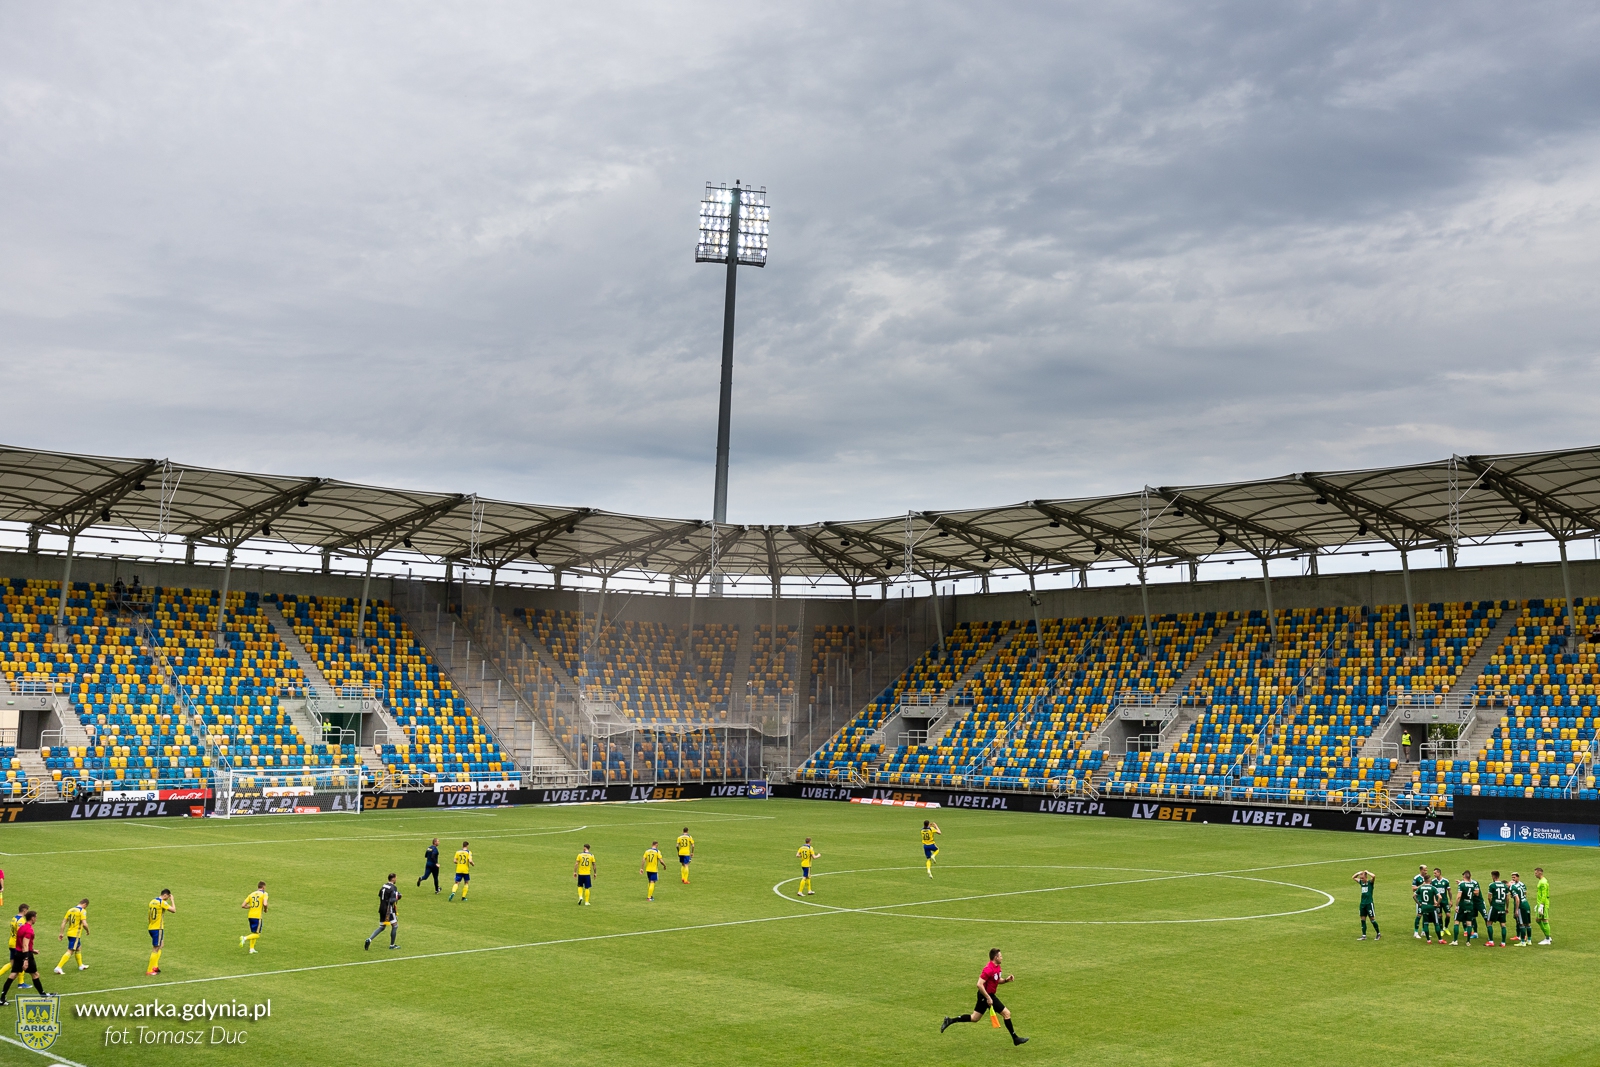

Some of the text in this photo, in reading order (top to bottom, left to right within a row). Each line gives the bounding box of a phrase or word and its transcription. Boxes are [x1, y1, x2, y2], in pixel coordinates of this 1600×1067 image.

[40, 697, 47, 706] 9
[1123, 708, 1129, 716] G
[1404, 710, 1411, 719] G
[437, 791, 509, 806] LVBET.PL
[543, 789, 608, 803] LVBET.PL
[630, 786, 685, 800] LVBET
[801, 787, 853, 800] LVBET.PL
[947, 795, 1008, 809] LVBET.PL
[1039, 799, 1106, 815] LVBET.PL
[70, 802, 168, 818] LVBET.PL
[1131, 803, 1197, 821] LVBET
[1231, 809, 1313, 827] LVBET.PL
[1355, 816, 1447, 836] LVBET.PL
[1533, 831, 1576, 841] EKSTRAKLASA
[1422, 890, 1430, 902] 6
[1467, 888, 1473, 900] 4
[1495, 887, 1506, 900] 15
